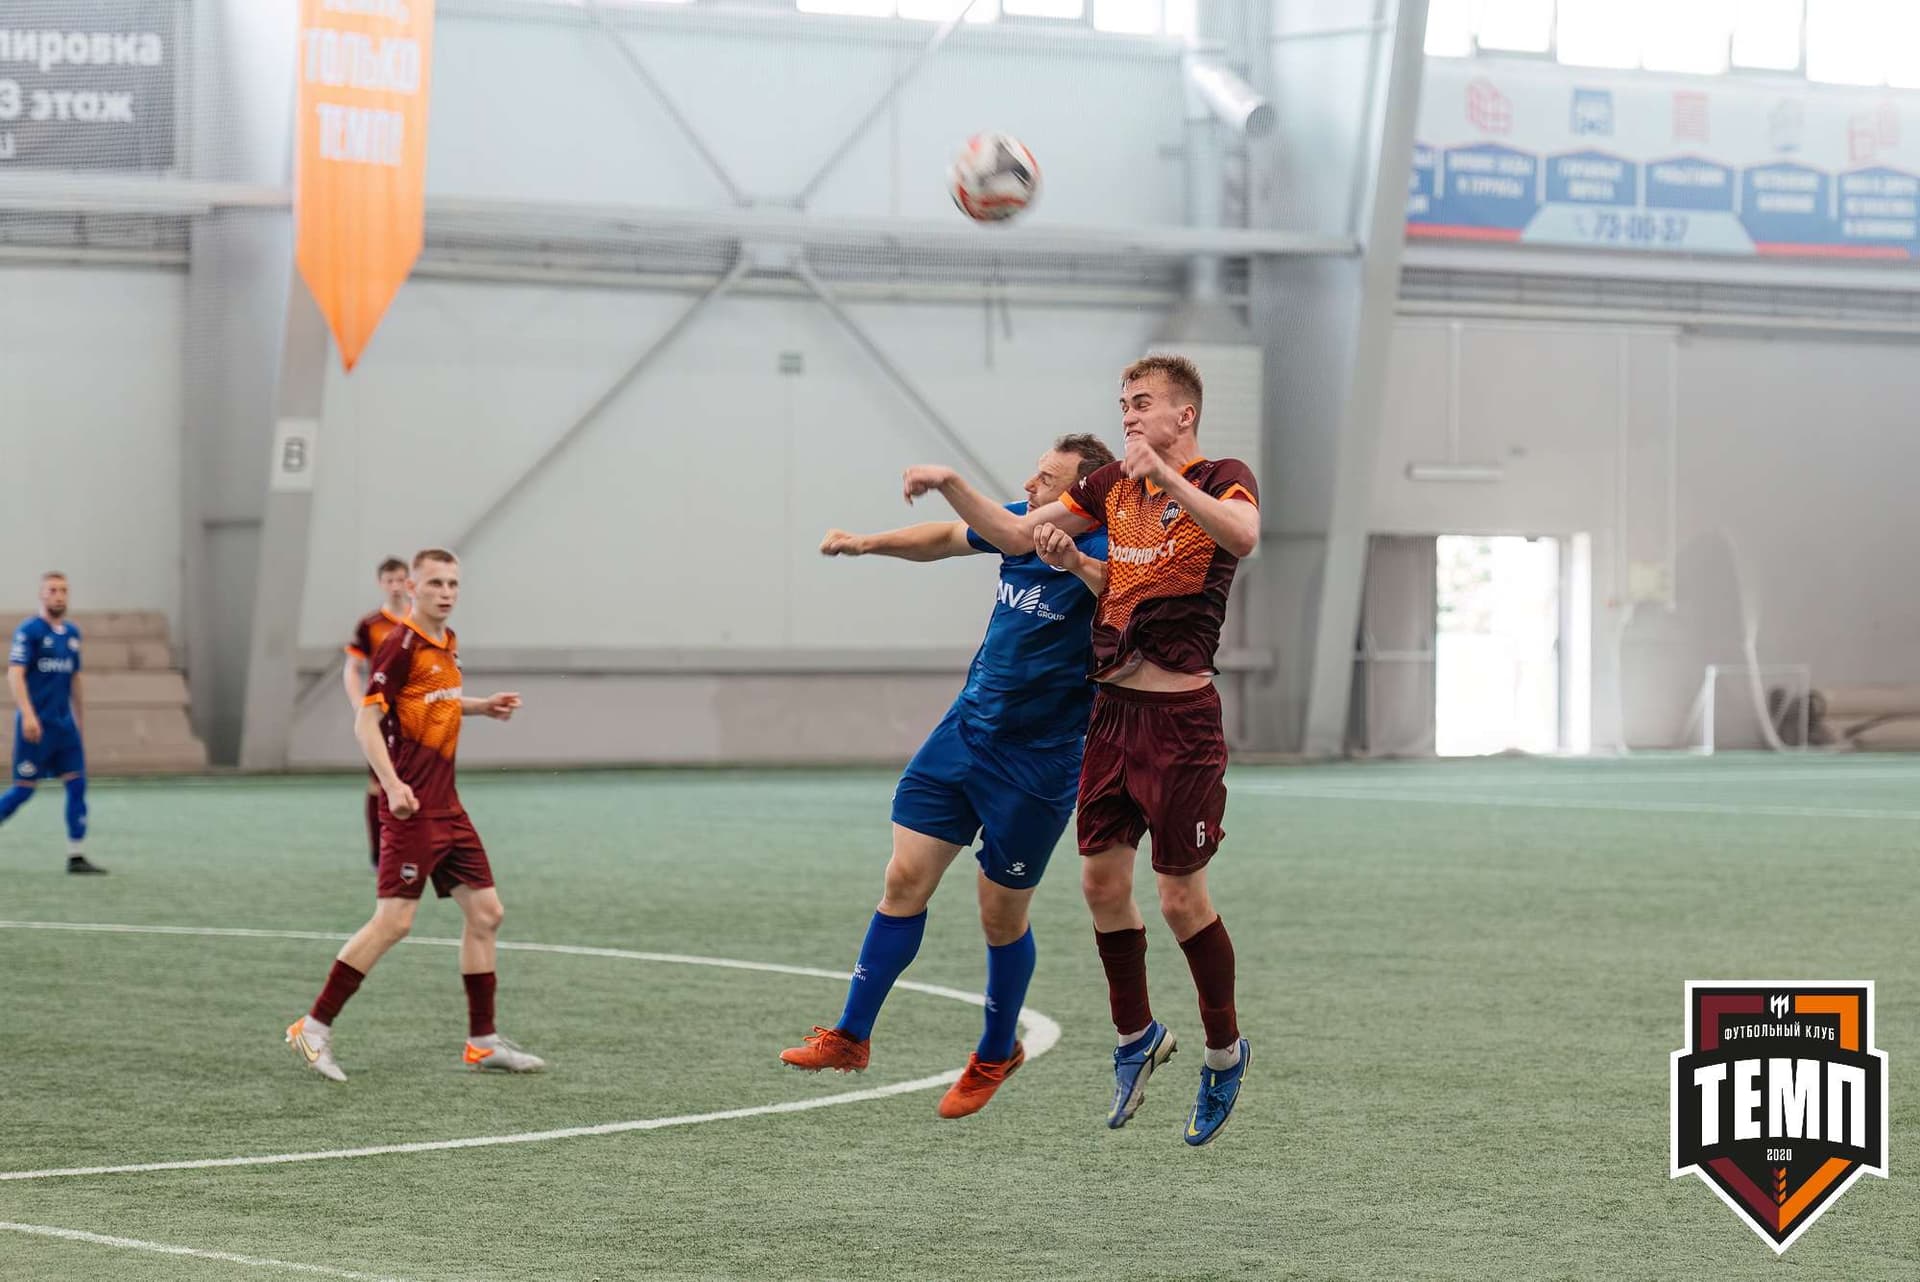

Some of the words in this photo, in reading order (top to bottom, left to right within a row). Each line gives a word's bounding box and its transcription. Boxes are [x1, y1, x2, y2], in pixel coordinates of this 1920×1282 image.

[30, 90, 133, 121] этаж
[1037, 610, 1065, 621] GROUP
[1038, 602, 1051, 612] OIL
[1196, 821, 1206, 848] 6
